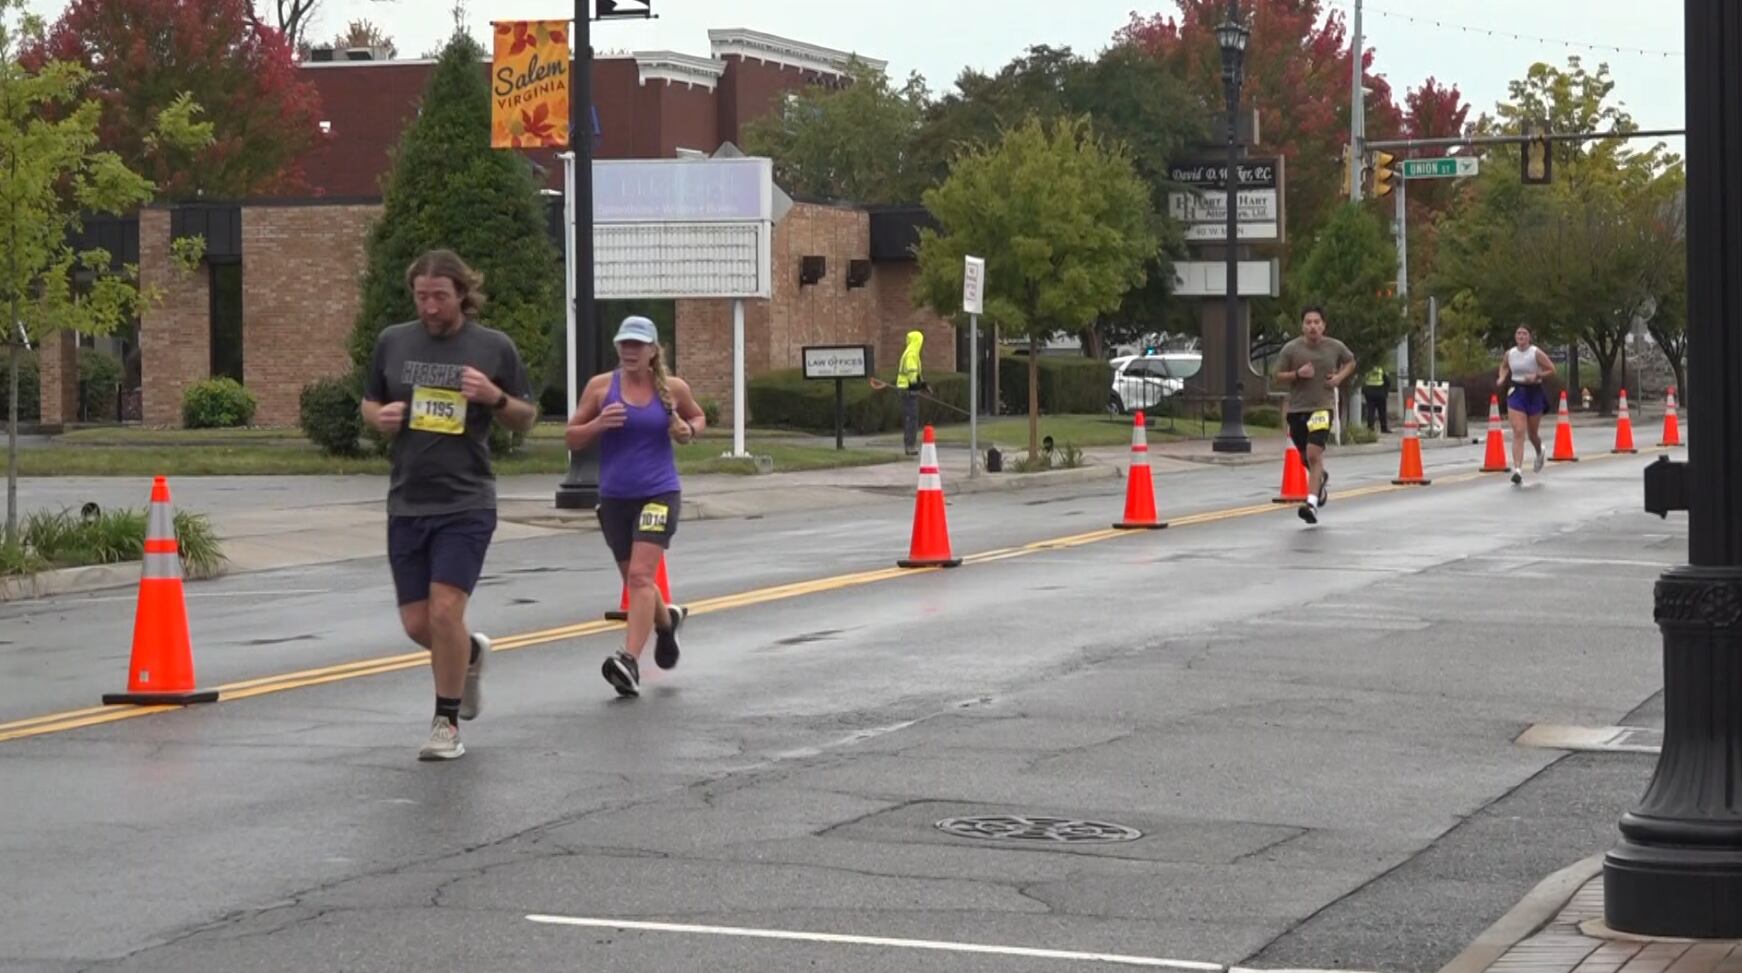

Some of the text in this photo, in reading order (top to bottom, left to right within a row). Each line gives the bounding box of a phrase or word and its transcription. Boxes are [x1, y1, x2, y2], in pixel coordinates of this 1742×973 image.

[495, 54, 566, 96] Salem
[497, 80, 566, 110] VIRGINIA
[1172, 167, 1204, 180] David
[1410, 163, 1451, 174] UNION ST
[1239, 195, 1266, 206] HART
[807, 359, 826, 368] LAW
[402, 361, 464, 388] HERSHE
[426, 401, 454, 417] 1195
